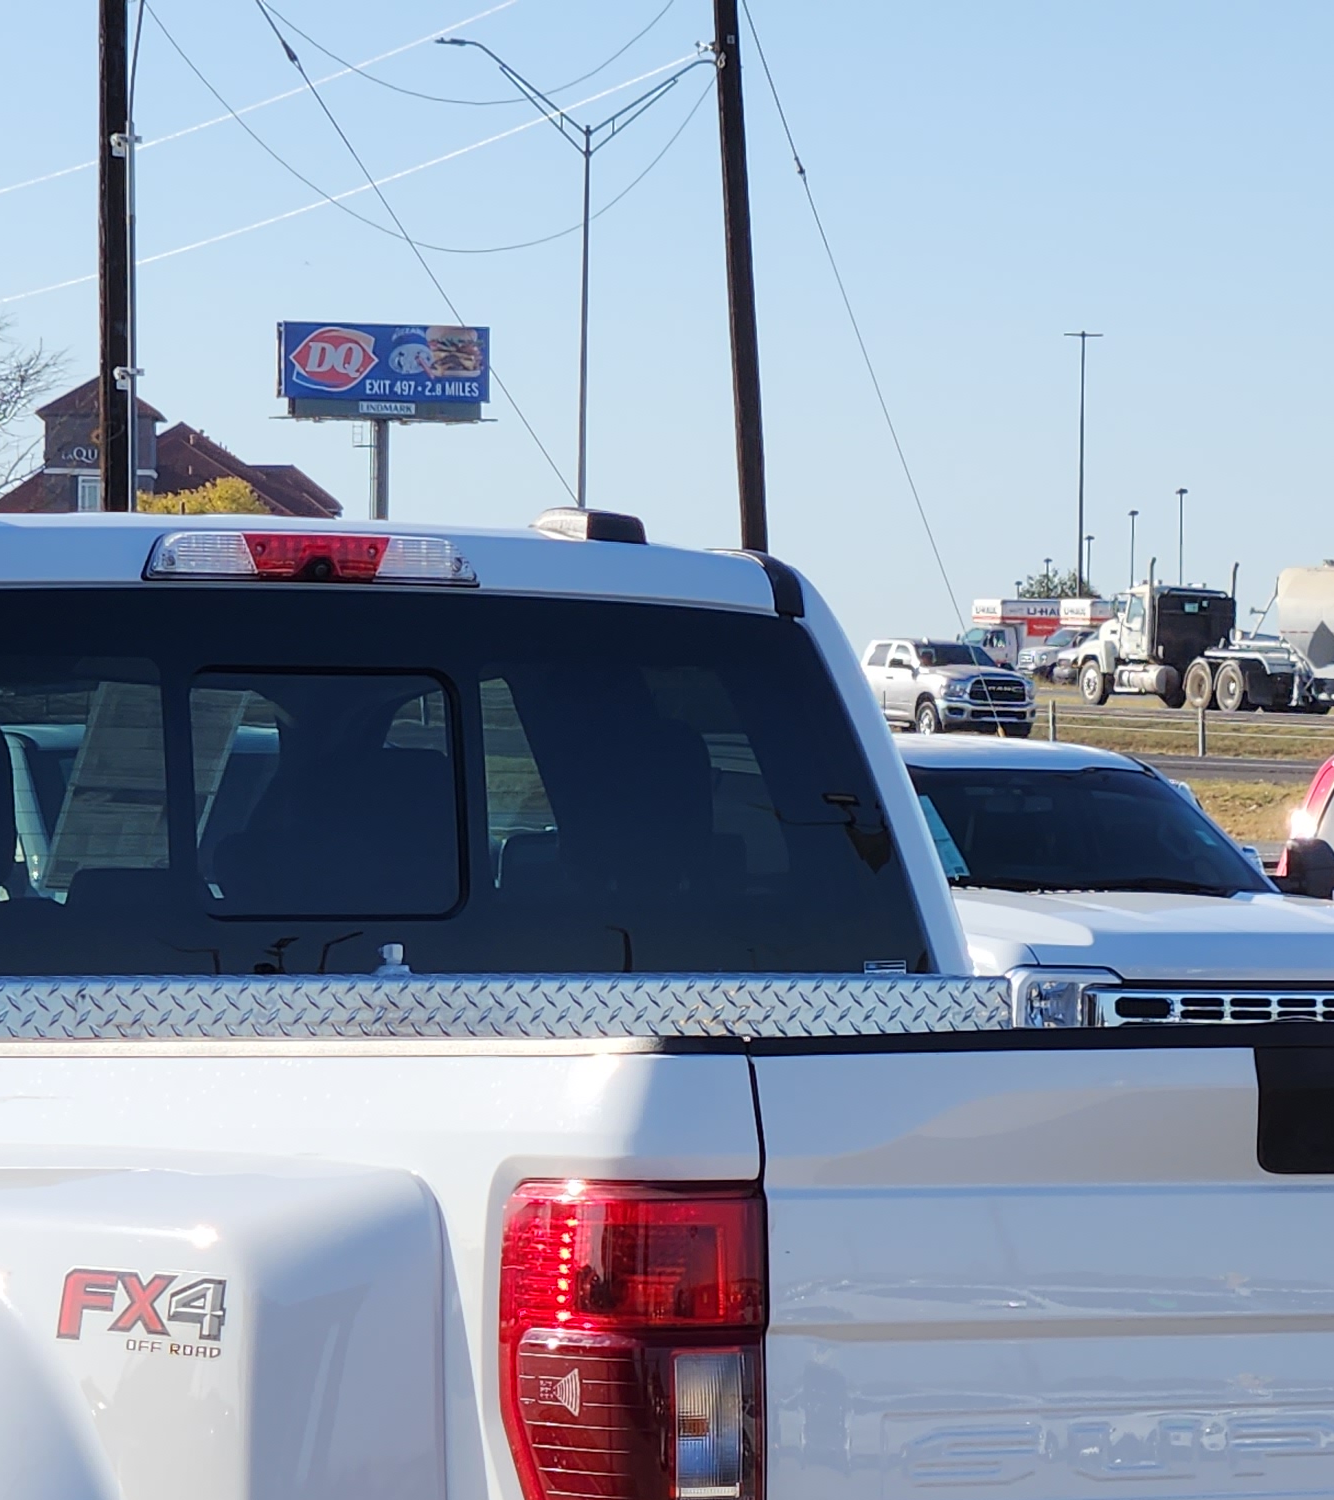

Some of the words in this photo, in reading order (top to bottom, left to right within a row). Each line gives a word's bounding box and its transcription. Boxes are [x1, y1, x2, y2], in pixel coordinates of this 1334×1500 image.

[305, 341, 364, 378] DQ
[365, 379, 391, 396] EXIT
[393, 380, 416, 396] 497
[425, 381, 442, 397] 2.8
[445, 381, 480, 397] MILES
[56, 1267, 228, 1342] FX4
[125, 1339, 163, 1354] OFF
[169, 1342, 222, 1359] ROAD
